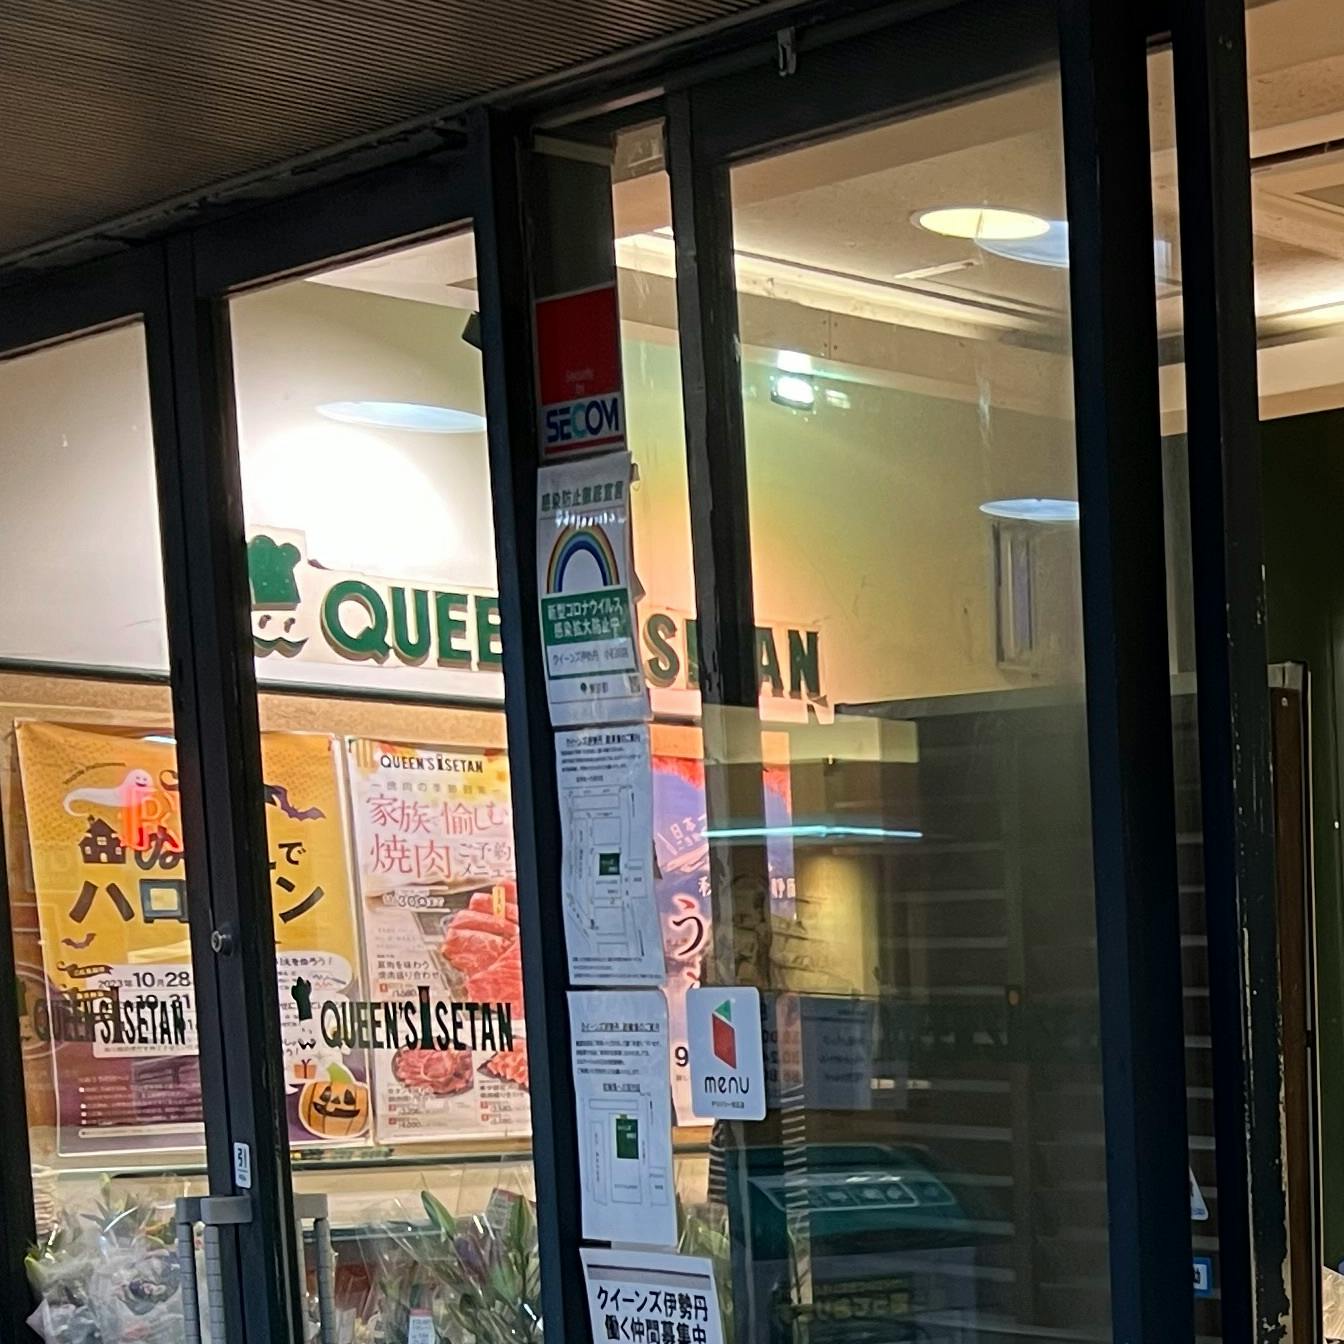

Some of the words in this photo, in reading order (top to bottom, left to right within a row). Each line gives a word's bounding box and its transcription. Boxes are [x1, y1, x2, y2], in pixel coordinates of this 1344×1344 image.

[546, 397, 620, 444] SECOM
[380, 754, 435, 771] QUEEN'S
[370, 833, 451, 880] 焼肉
[320, 1000, 417, 1050] QUEEN'S
[417, 986, 515, 1051] ISETAN
[704, 1076, 750, 1094] menu
[597, 1285, 709, 1320] クイーンズ伊勢丹
